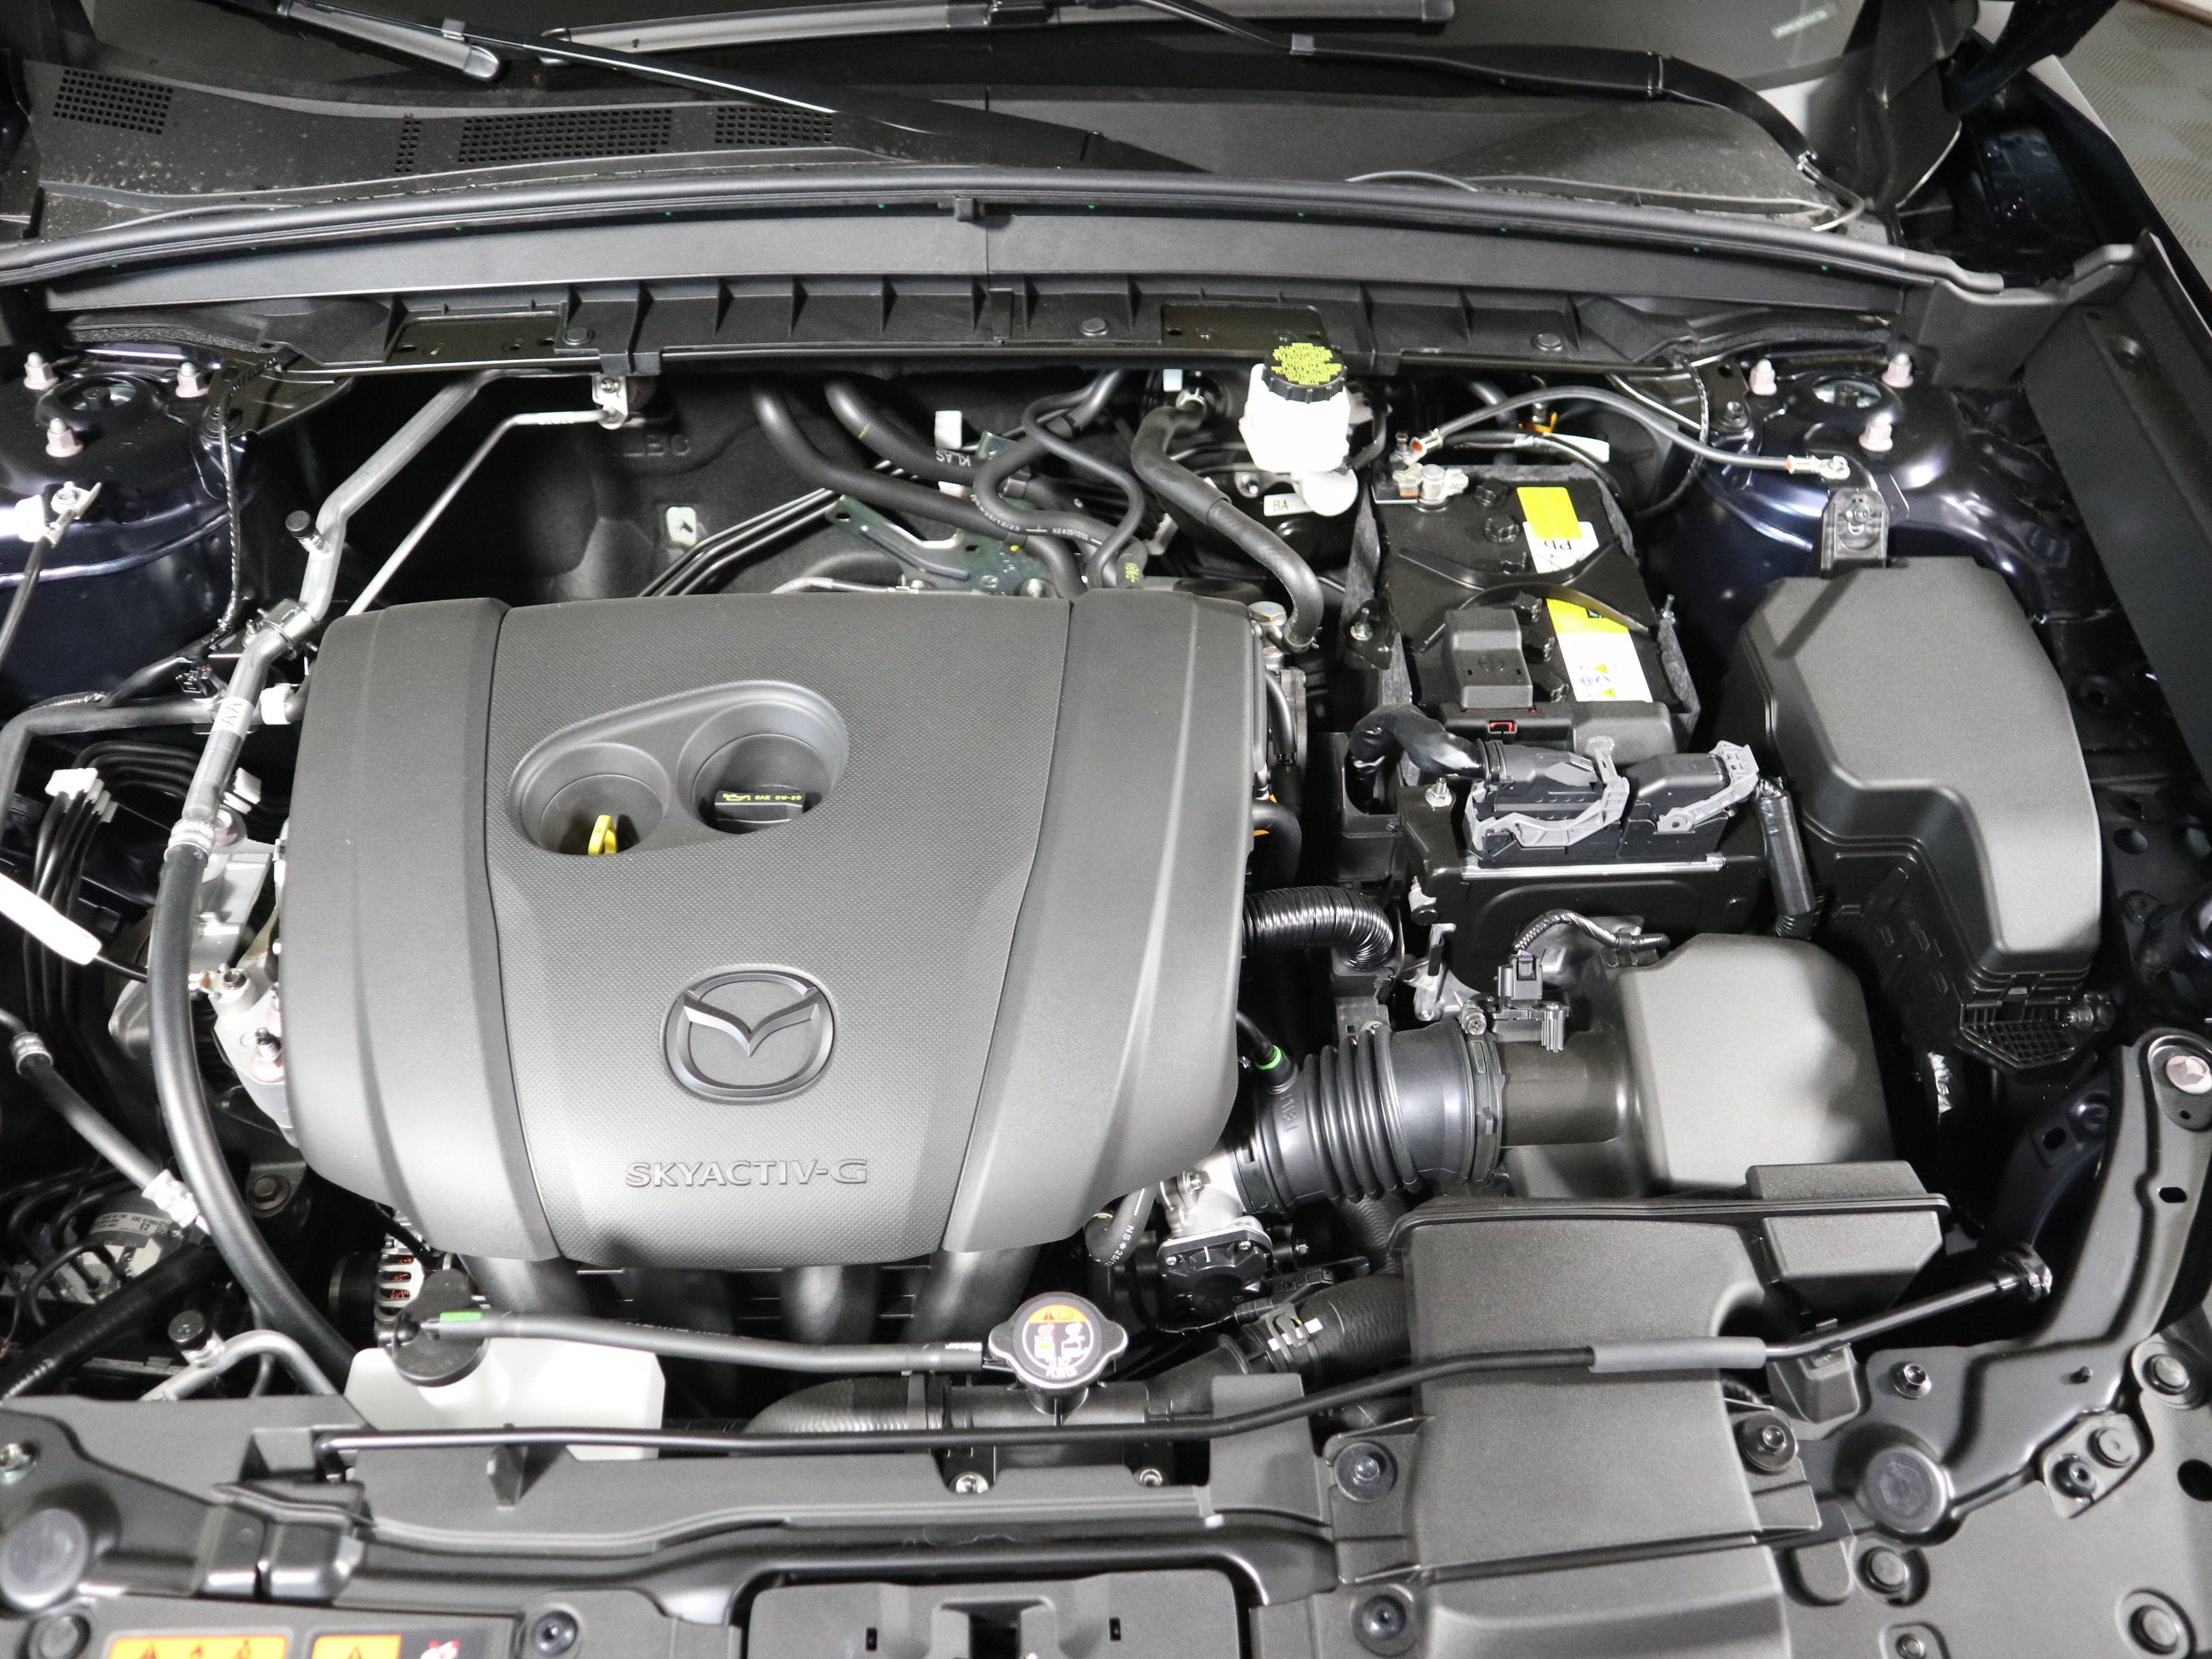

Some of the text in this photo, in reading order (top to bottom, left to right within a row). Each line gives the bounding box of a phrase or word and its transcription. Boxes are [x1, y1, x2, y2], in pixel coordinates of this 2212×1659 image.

[1273, 500, 1289, 511] BA
[220, 703, 243, 727] AA
[625, 1158, 868, 1188] SKYACTIV-G
